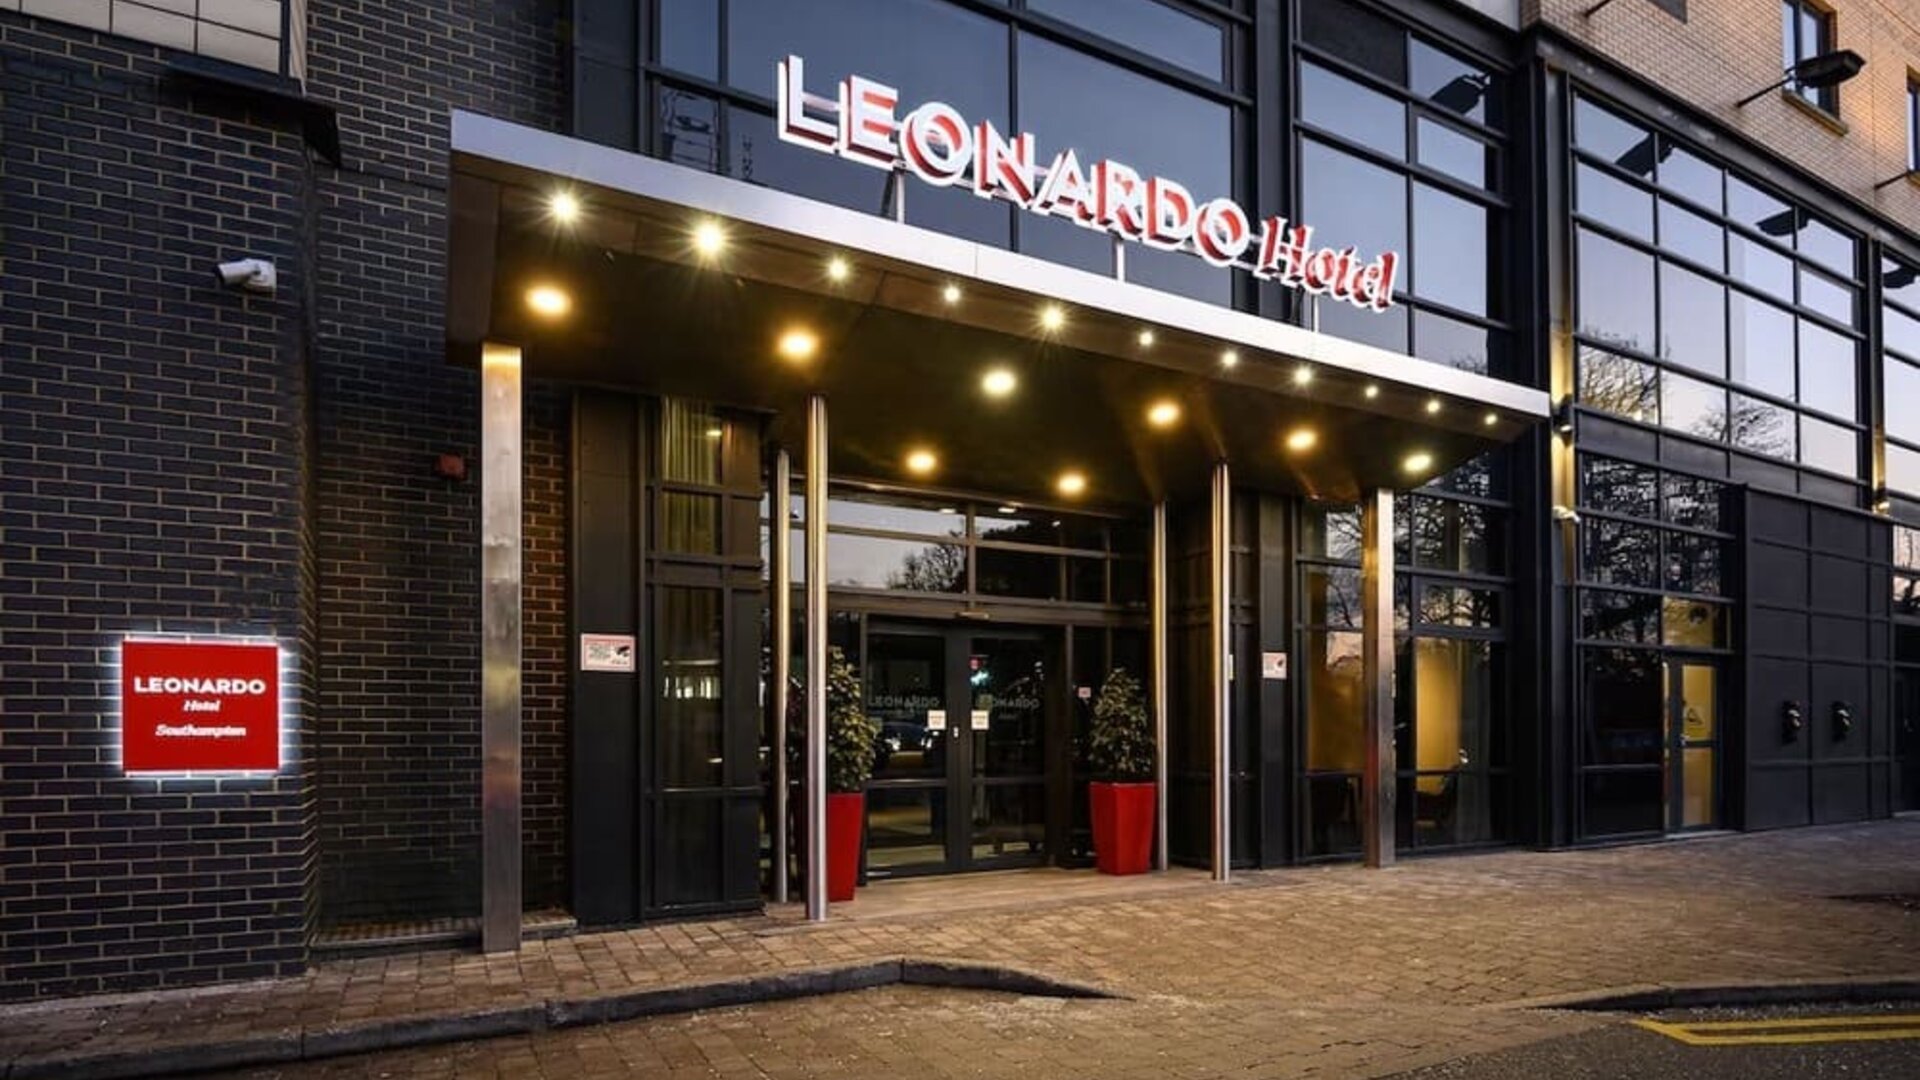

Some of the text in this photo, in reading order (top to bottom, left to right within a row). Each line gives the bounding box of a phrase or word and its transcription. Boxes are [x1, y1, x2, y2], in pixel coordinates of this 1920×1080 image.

[777, 54, 1399, 313] LEONARDO Hotel
[134, 677, 266, 694] LEONARDO
[183, 700, 221, 712] Hotel
[155, 724, 247, 738] Southampton
